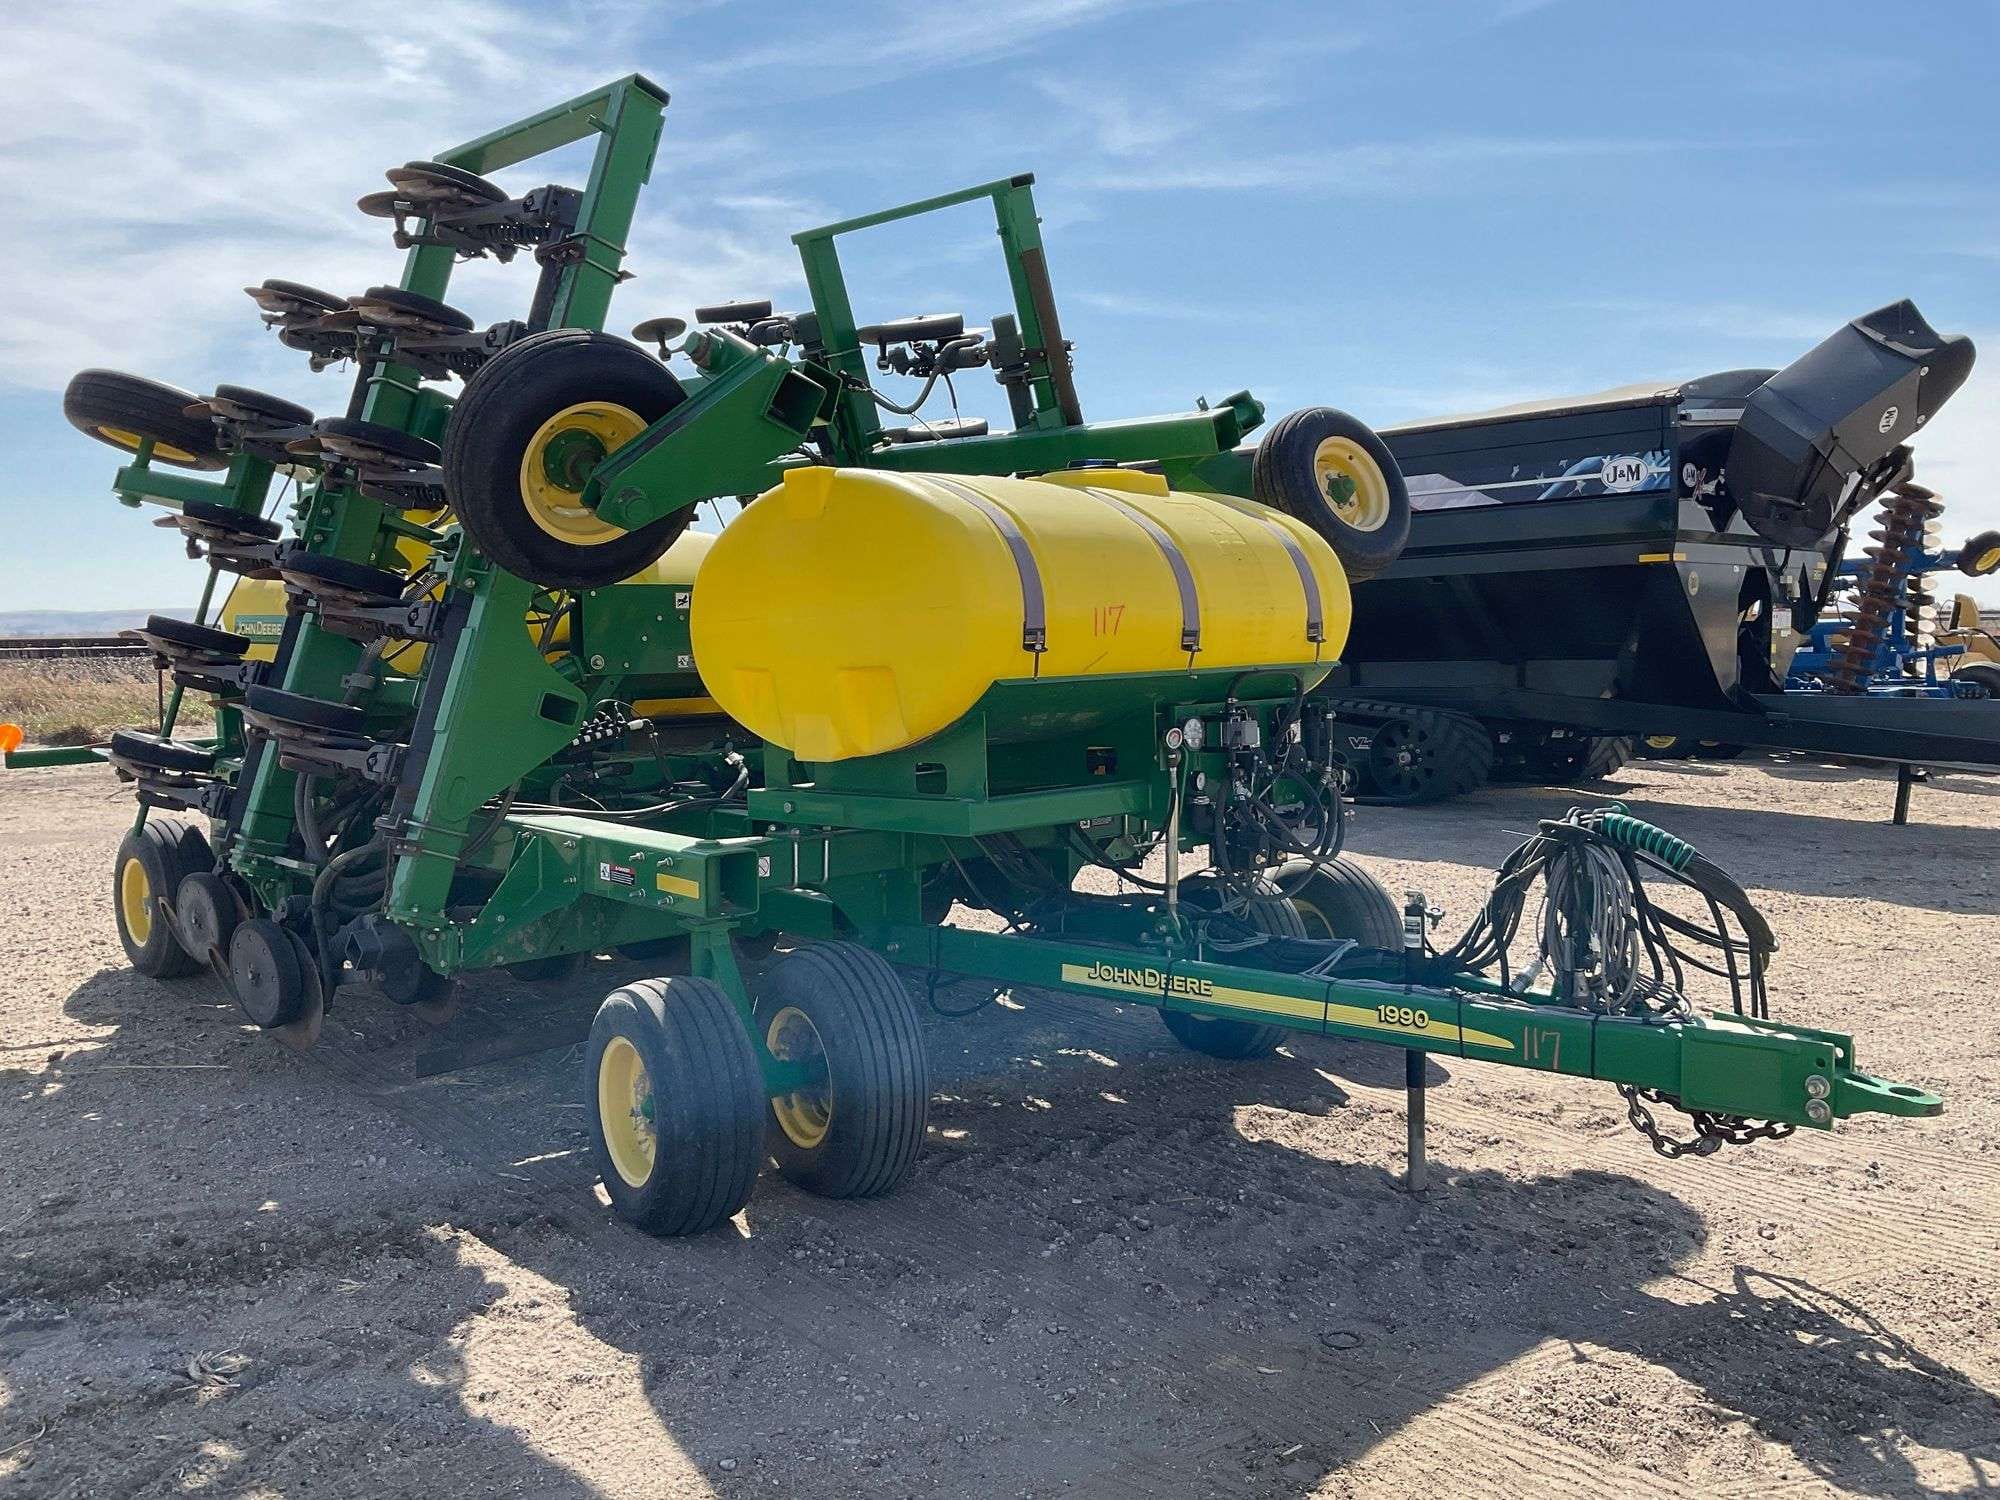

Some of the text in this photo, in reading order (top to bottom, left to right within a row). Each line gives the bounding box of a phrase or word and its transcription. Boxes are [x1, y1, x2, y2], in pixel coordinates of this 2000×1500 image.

[1606, 463, 1641, 484] J&M
[1094, 604, 1126, 637] 117
[1088, 961, 1142, 986] JOHN
[1377, 1004, 1430, 1028] 1990
[1523, 1025, 1561, 1071] 117
